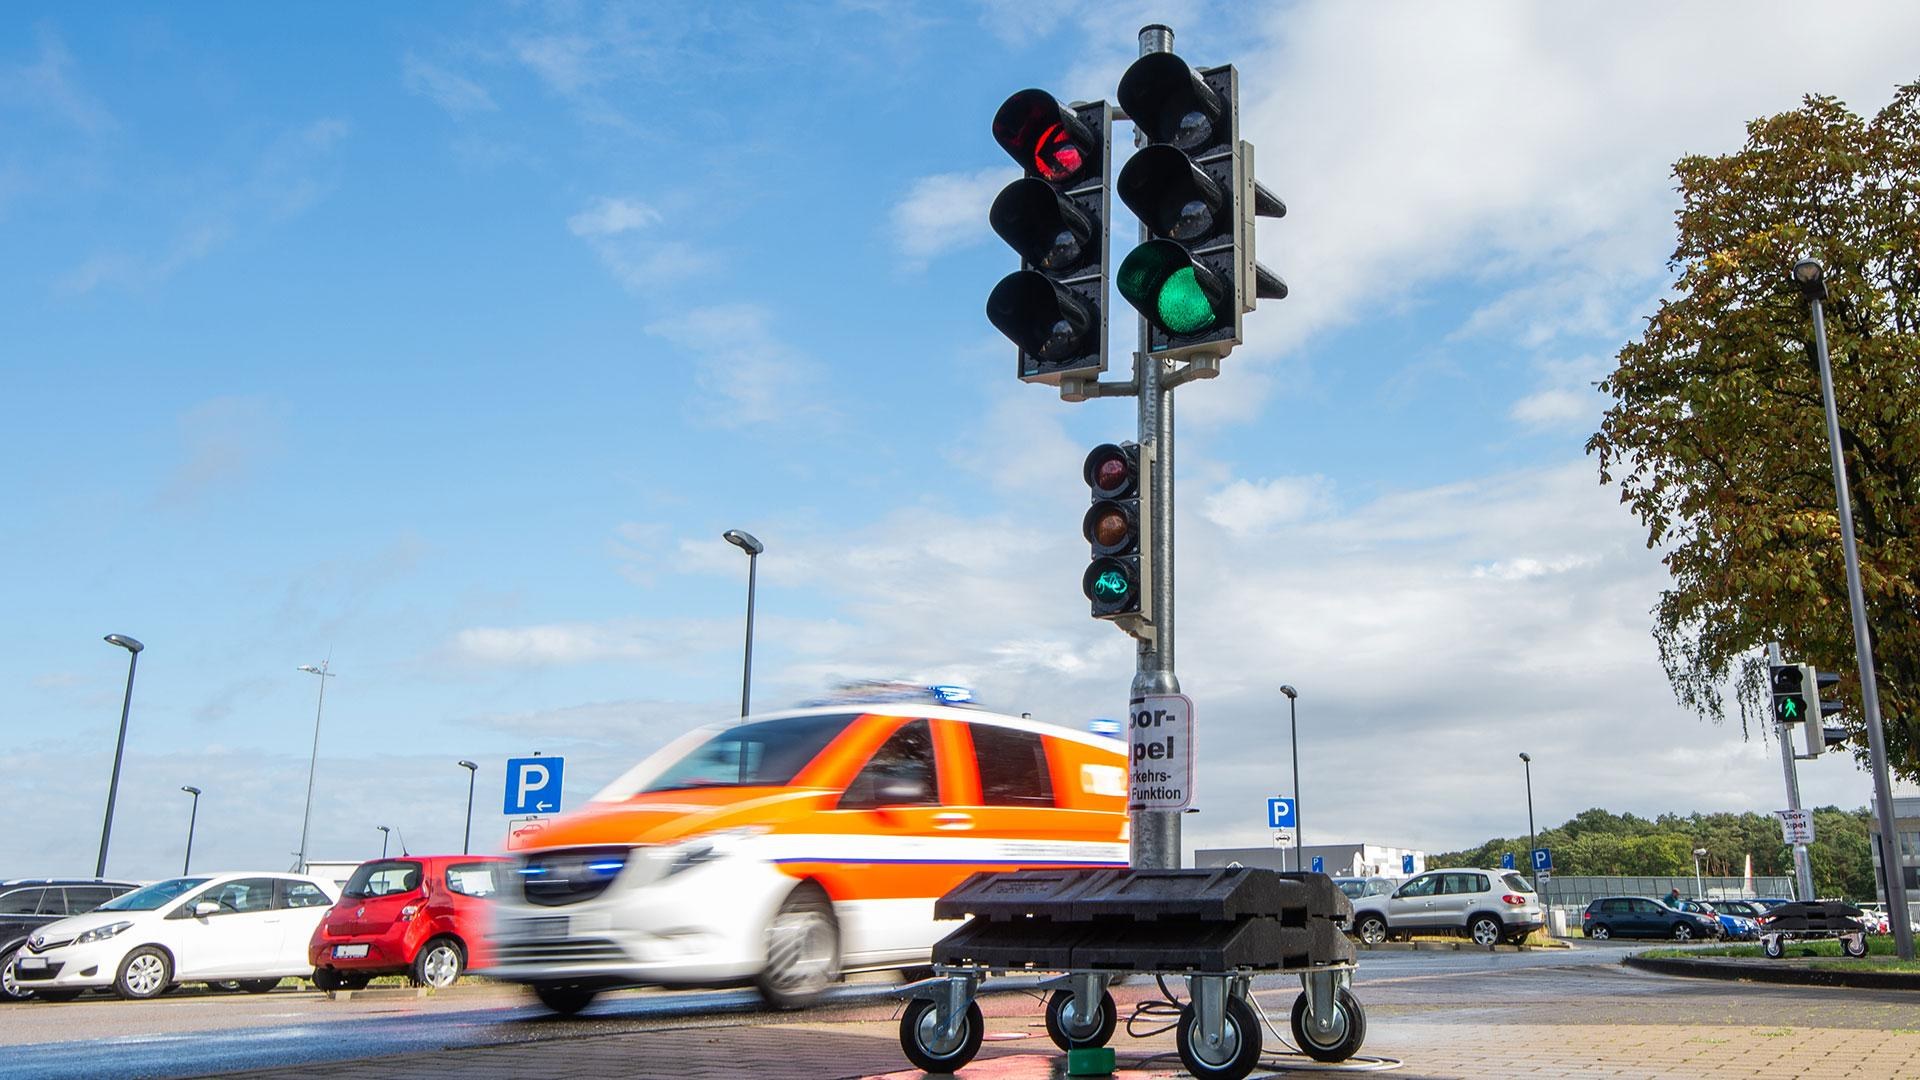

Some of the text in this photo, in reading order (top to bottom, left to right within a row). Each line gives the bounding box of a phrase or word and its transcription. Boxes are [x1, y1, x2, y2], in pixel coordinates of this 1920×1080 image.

[1130, 736, 1174, 766] pel
[517, 764, 550, 808] P
[1132, 786, 1180, 800] Funktion
[1274, 802, 1289, 825] P
[1313, 858, 1318, 866] P
[1504, 856, 1510, 864] P
[1536, 852, 1546, 867] P
